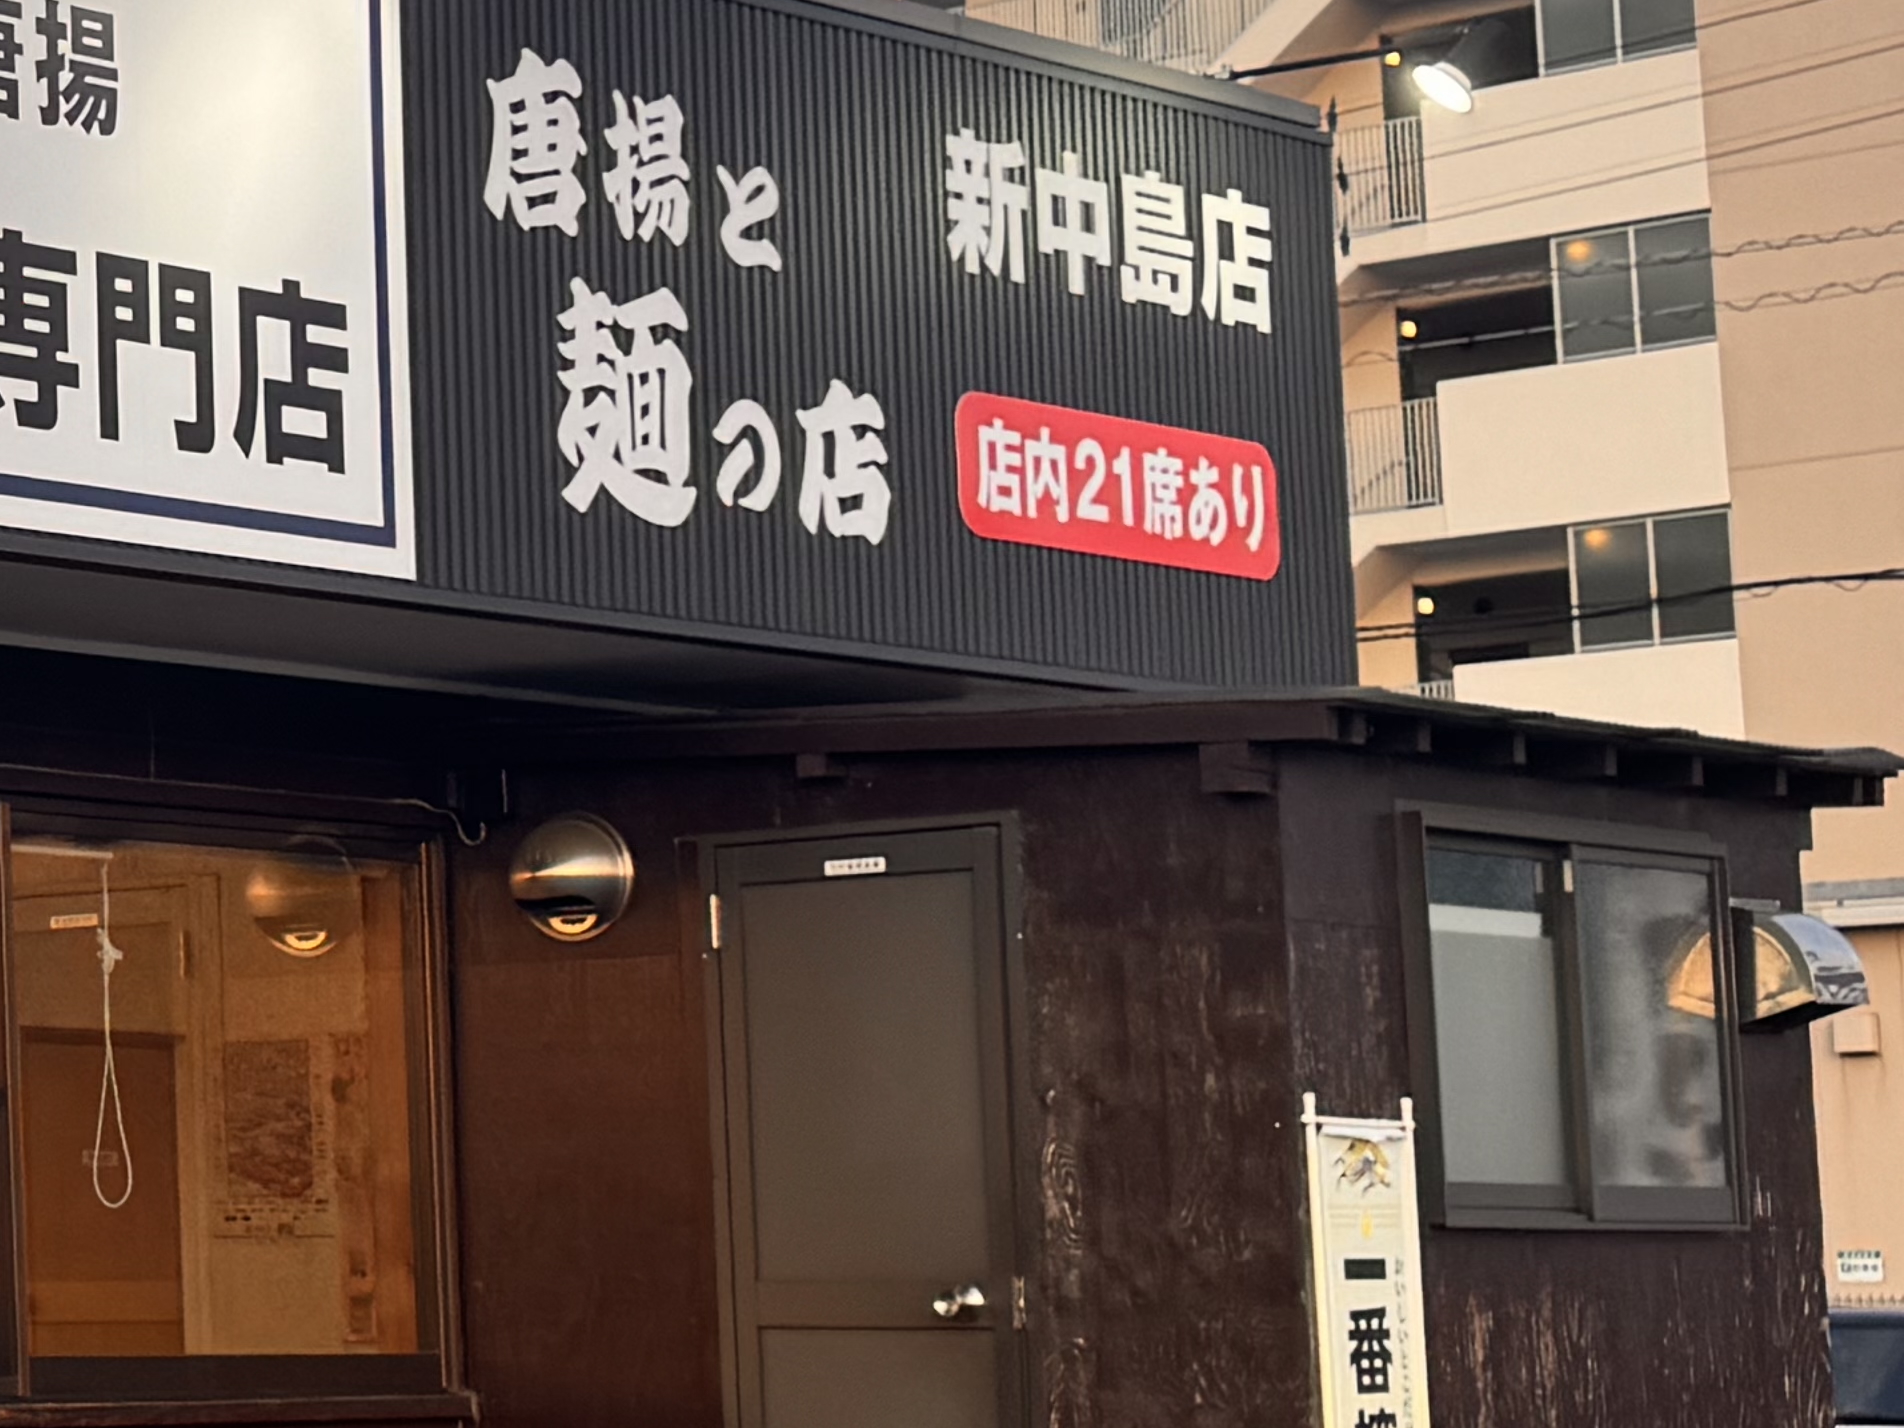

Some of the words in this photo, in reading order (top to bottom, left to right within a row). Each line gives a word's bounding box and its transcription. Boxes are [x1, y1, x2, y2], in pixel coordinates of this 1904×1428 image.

[483, 47, 782, 271] 唐揚と
[945, 127, 1273, 334] 新中島店
[556, 277, 891, 545] 麺の店
[976, 418, 1265, 553] 店内21席あり
